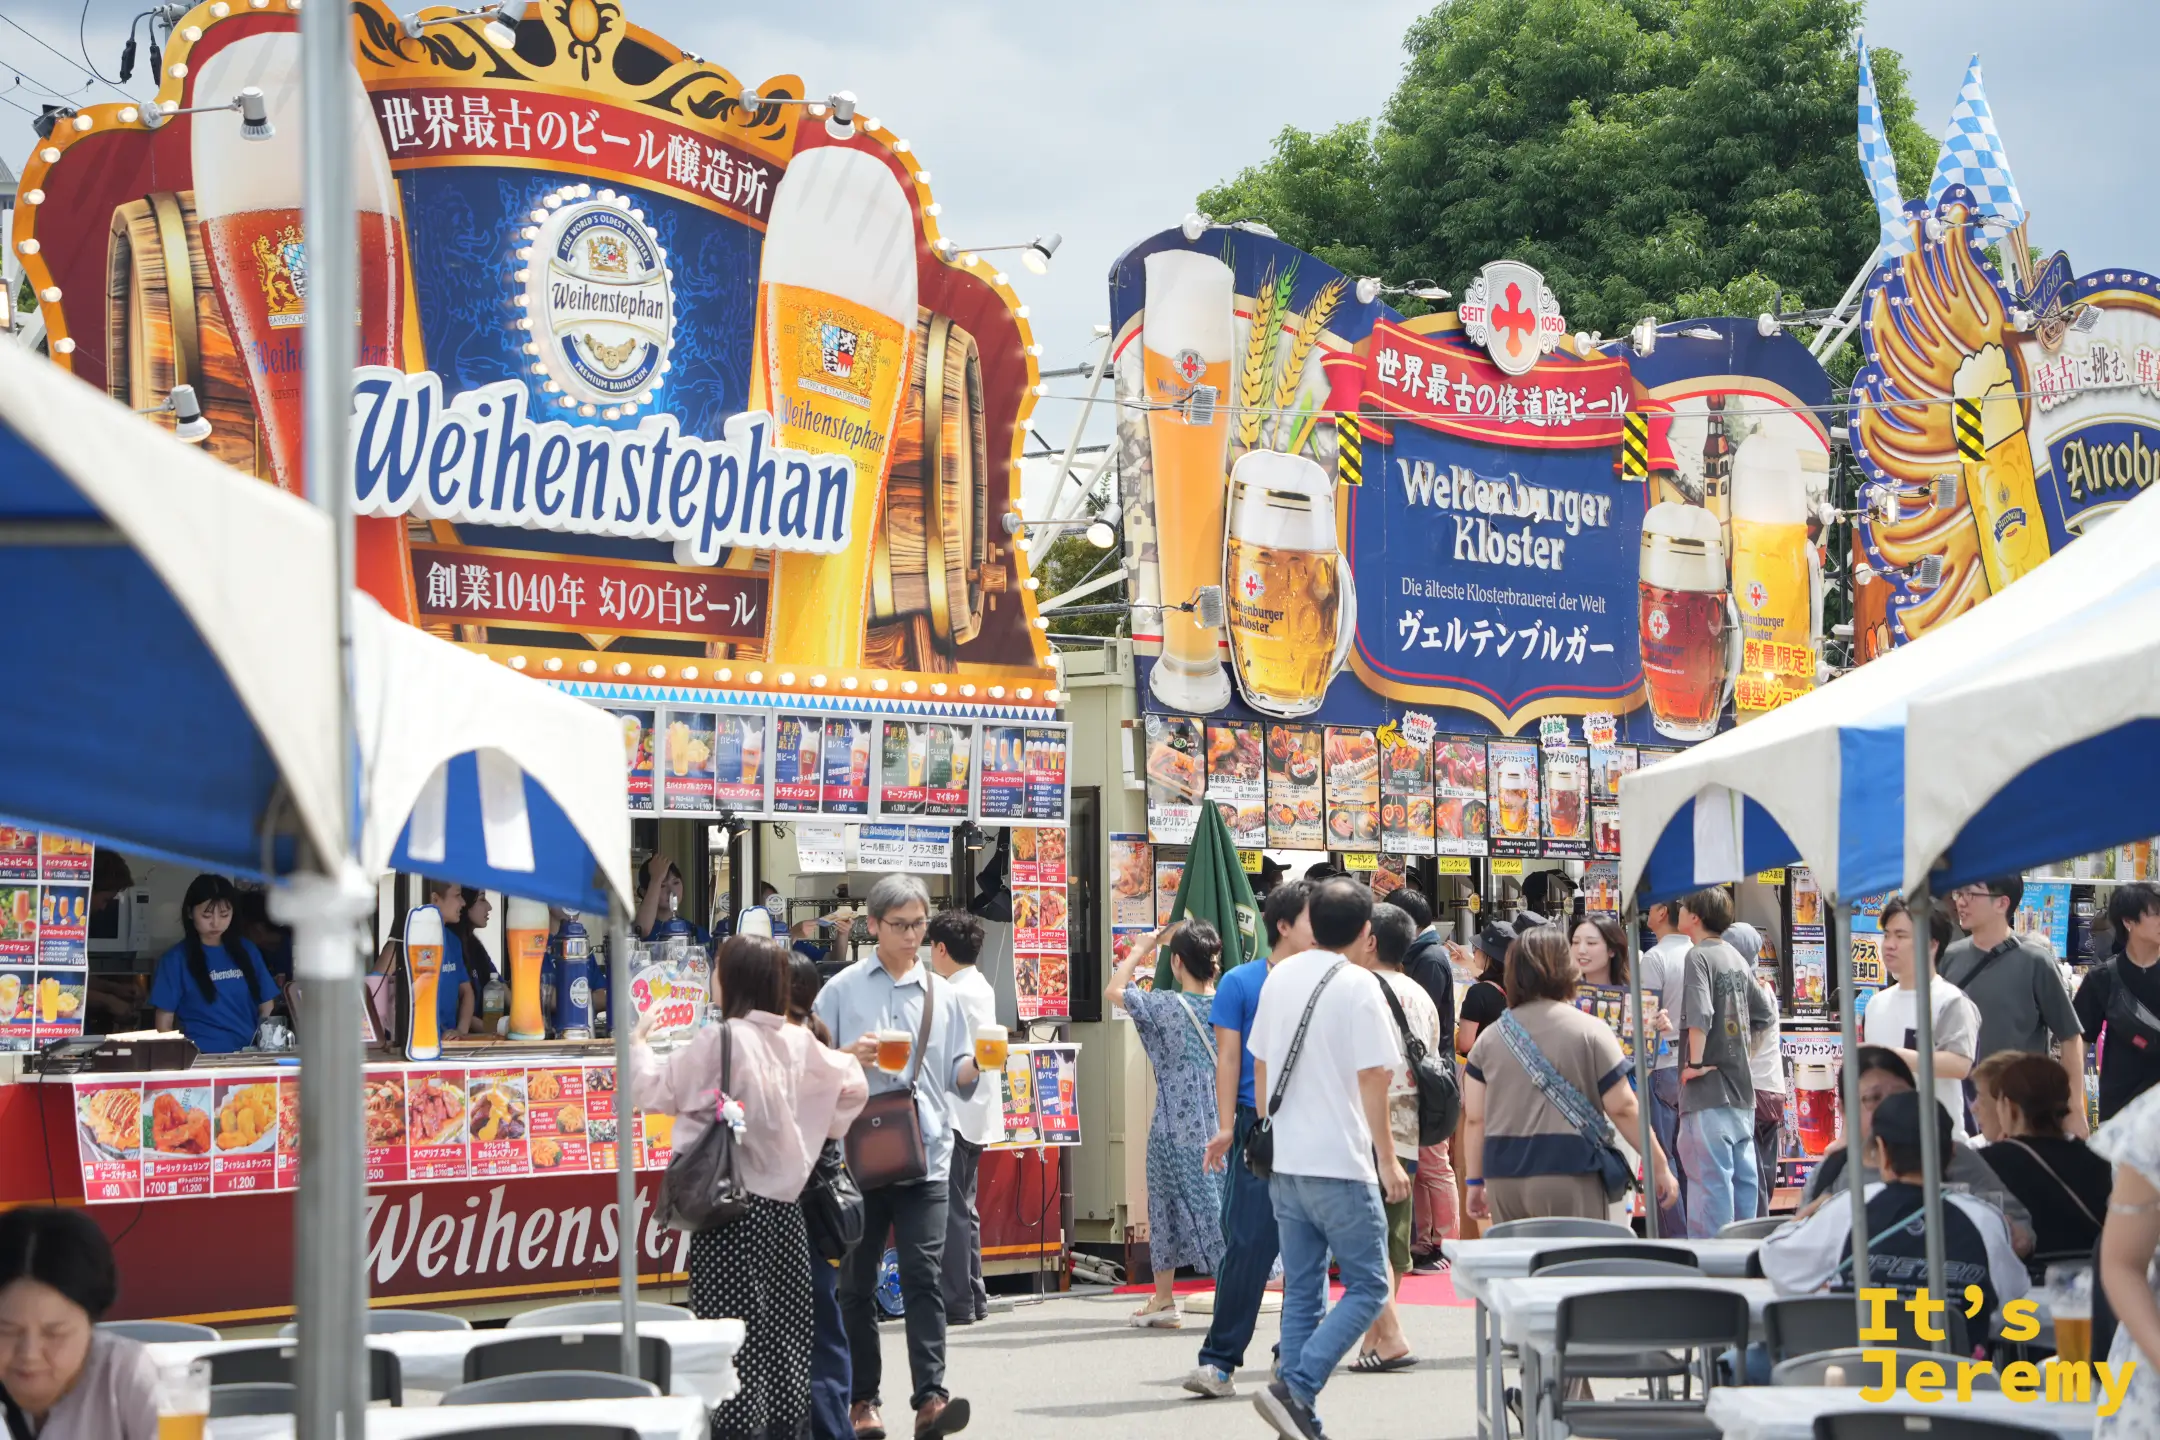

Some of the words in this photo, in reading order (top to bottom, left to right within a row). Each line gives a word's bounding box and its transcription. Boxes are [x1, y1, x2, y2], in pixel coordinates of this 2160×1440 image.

[381, 95, 769, 214] 世界最古のビール醸造所
[561, 236, 573, 251] THE
[571, 215, 599, 237] WORLD'S
[600, 215, 626, 229] OLDEST
[626, 226, 652, 265] BREWERY
[551, 282, 664, 320] Weihenstephan
[1461, 305, 1485, 323] SEIT
[1540, 317, 1564, 332] 1050
[575, 361, 608, 389] PREMIUM
[609, 368, 648, 390] BAVARICUM
[1376, 348, 1629, 426] 世界最古の修道院ビール
[780, 394, 884, 453] Weihenstephan
[353, 379, 850, 554] Weihenstephan
[1397, 458, 1612, 536] Weltenburger
[1450, 515, 1565, 571] Kloster
[427, 562, 585, 619] 創業1040年
[598, 579, 757, 629] 幻の白ビール
[1401, 577, 1422, 597] Die
[1425, 580, 1465, 601] älteste
[1467, 583, 1556, 609] Klosterbrauerei
[1559, 593, 1577, 611] der
[1580, 594, 1606, 614] Welt
[1239, 614, 1269, 633] Kloster
[1741, 609, 1784, 630] eltenburger
[1399, 609, 1614, 665] ヴェルテンブルガー
[776, 786, 816, 798] トラディション
[838, 788, 854, 799] IPA
[860, 843, 903, 853] ビール販売レジ
[912, 844, 945, 855] グラス返却
[861, 856, 876, 865] Beer
[877, 857, 903, 866] Cashier
[908, 859, 931, 867] Return
[931, 860, 948, 869] glass
[1347, 854, 1373, 863] フードレジ
[1851, 942, 1877, 960] グラス
[1053, 1118, 1067, 1128] IPA
[413, 1150, 438, 1158] スペアリブ
[440, 1148, 462, 1156] ステーキ
[101, 1170, 138, 1180] チーズナチョス
[156, 1164, 181, 1173] ガーリック
[182, 1161, 210, 1171] シュリンプ
[102, 1184, 120, 1197] ¥900
[146, 1181, 166, 1193] ¥700
[182, 1184, 202, 1193] ¥1,200
[228, 1176, 256, 1189] ¥1,200
[364, 1184, 690, 1284] Weihenste
